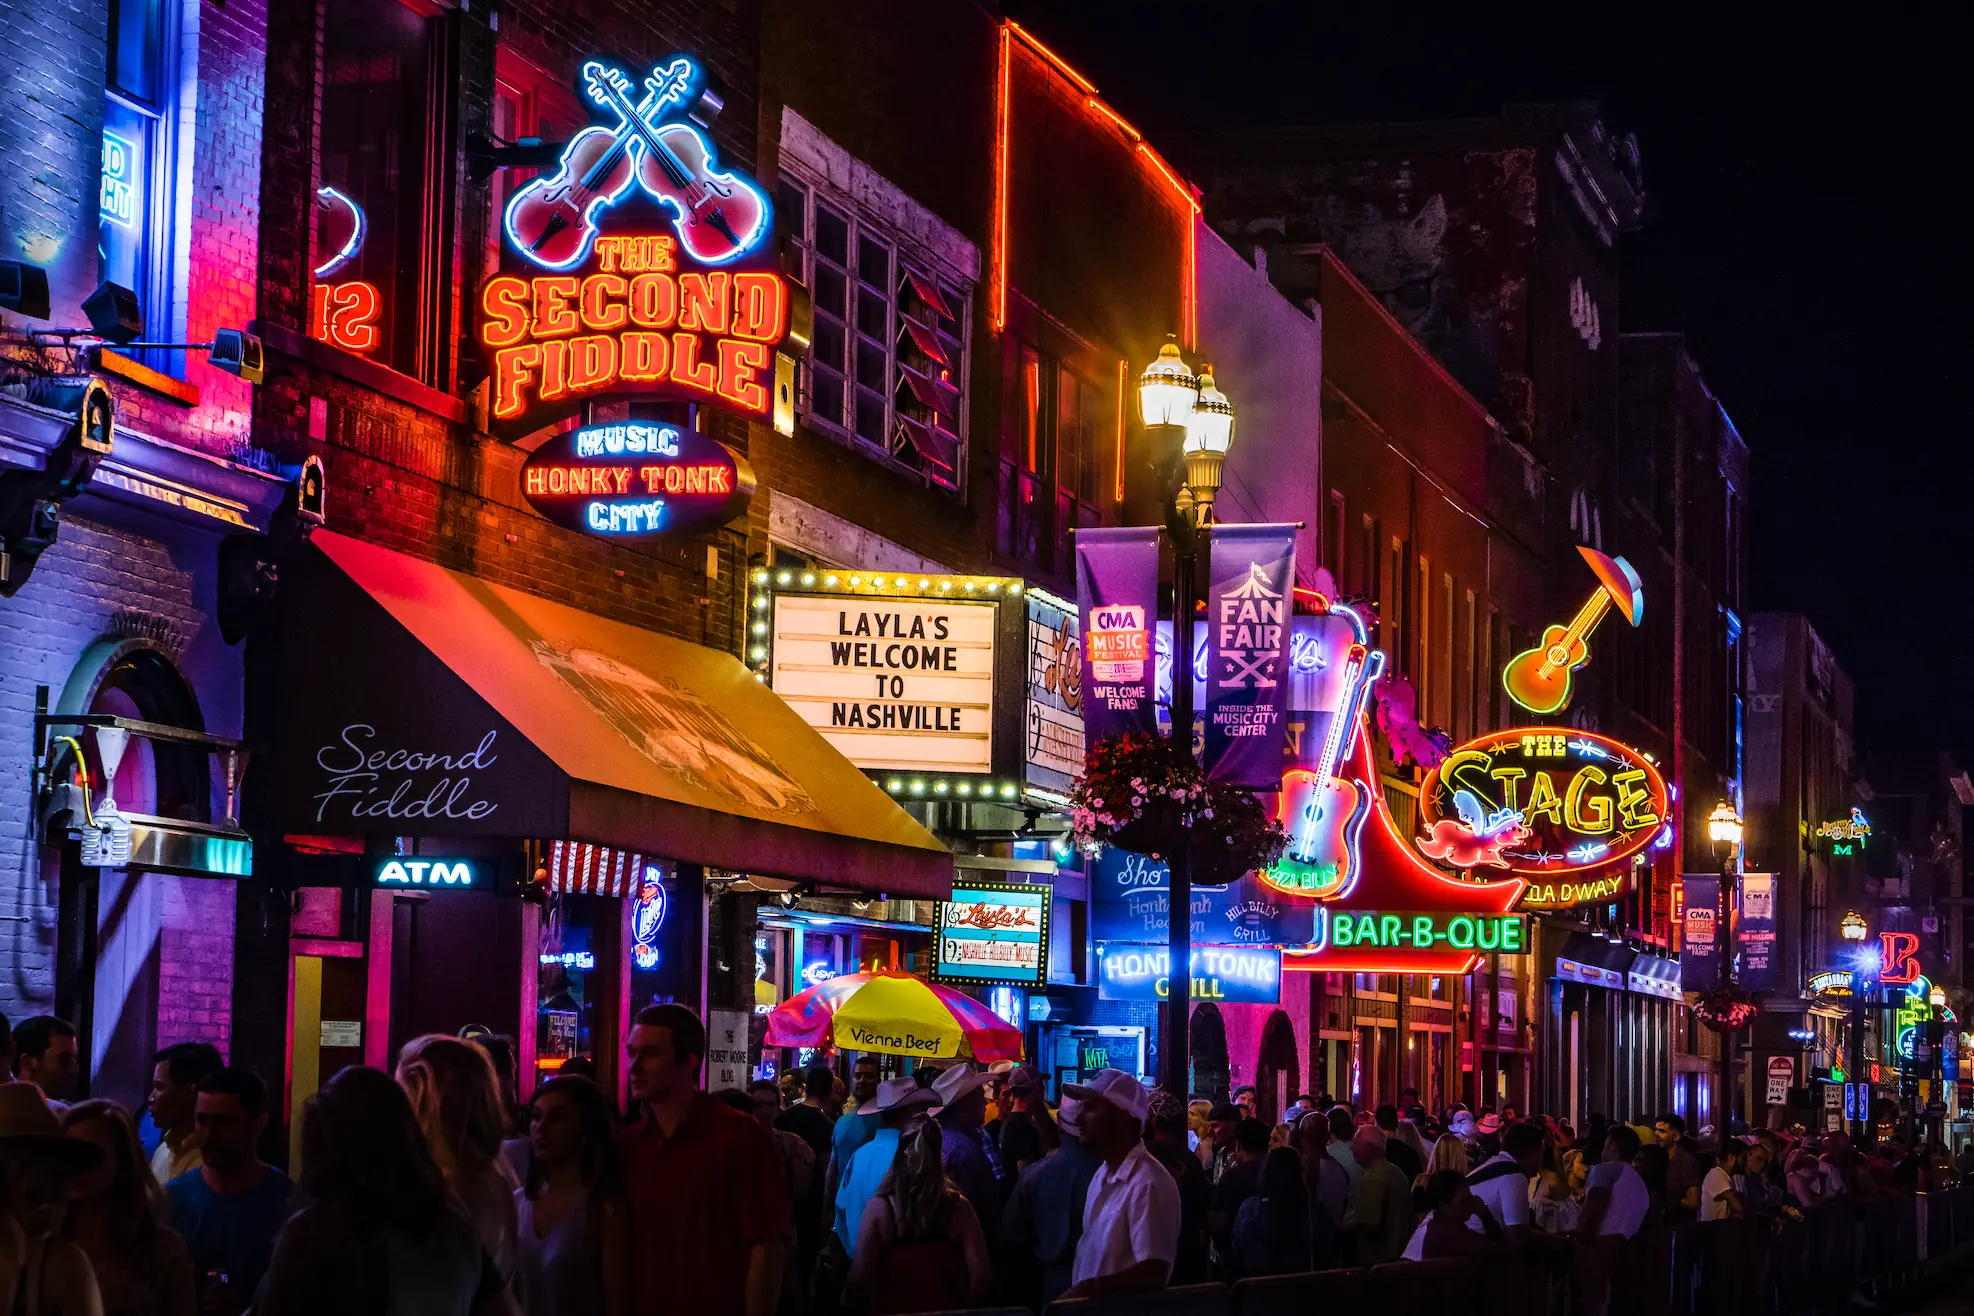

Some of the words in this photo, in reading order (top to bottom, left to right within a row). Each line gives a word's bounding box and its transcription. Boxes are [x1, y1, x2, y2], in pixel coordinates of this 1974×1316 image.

[595, 236, 675, 272] THE
[483, 272, 786, 344] SECOND
[495, 332, 772, 416] FIDDLE
[577, 425, 679, 457] MUSIC
[526, 466, 633, 495] HONKY
[640, 466, 731, 495] TONK
[588, 501, 664, 532] CITY
[1097, 612, 1137, 629] CMA
[1220, 600, 1283, 624] FAN
[839, 611, 949, 640] LAYLA'S
[1219, 625, 1282, 649] FAIR
[1093, 634, 1142, 651] MUSIC
[1094, 650, 1142, 659] FESTIVAL
[831, 641, 957, 671] WELCOME
[875, 675, 904, 699] TO
[1093, 686, 1145, 699] WELCOME
[1107, 698, 1138, 710] FANS!
[1218, 704, 1253, 713] INSIDE
[1255, 704, 1273, 712] THE
[832, 702, 961, 731] NASHVILLE
[1213, 712, 1251, 725] MUSIC
[1253, 711, 1279, 725] CITY
[1223, 724, 1267, 737] CENTER
[316, 724, 498, 773] Second
[1522, 735, 1567, 757] THE
[313, 773, 499, 822] Fiddle
[1440, 750, 1660, 835] STAGE
[378, 861, 472, 884] ATM
[959, 902, 1035, 929] Layla's
[1225, 902, 1248, 922] HILL
[1249, 901, 1280, 920] BILLY
[1689, 911, 1711, 920] CMA
[1233, 926, 1271, 942] GRILL
[1332, 913, 1523, 951] BAR-B-QUE
[1687, 920, 1714, 929] MUSIC
[1685, 943, 1714, 951] WELCOME
[1201, 952, 1277, 982] TONK
[851, 1027, 903, 1047] Vienna
[908, 1033, 942, 1055] Beef
